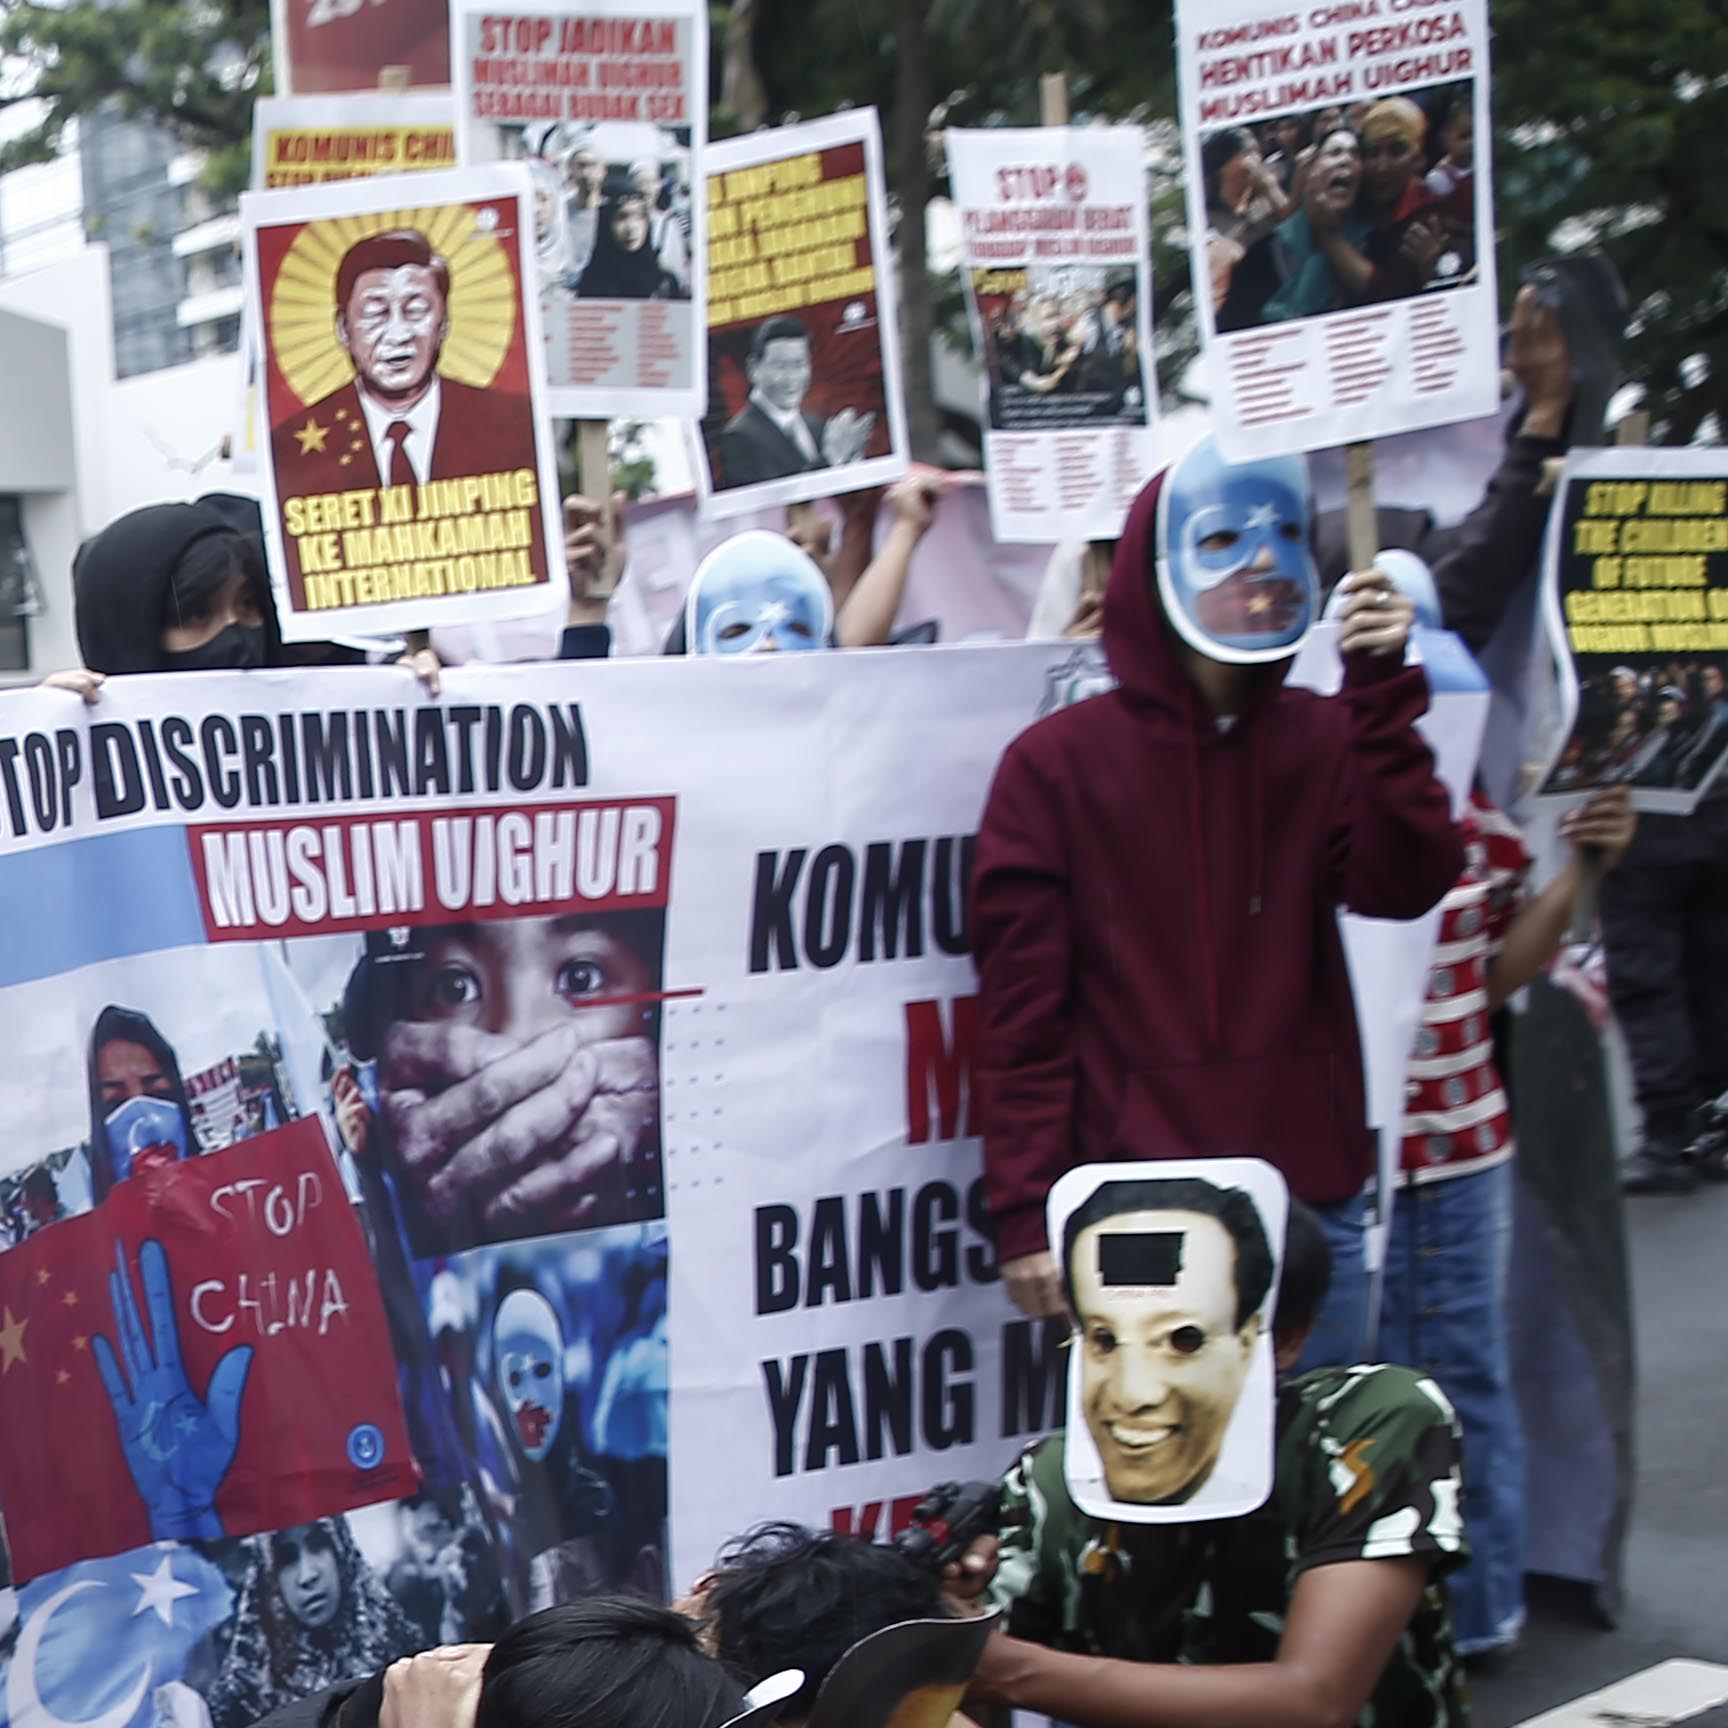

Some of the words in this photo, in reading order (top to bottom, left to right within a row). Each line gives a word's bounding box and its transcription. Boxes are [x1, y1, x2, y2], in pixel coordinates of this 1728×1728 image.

[482, 16, 551, 53] STOP
[560, 16, 677, 54] JADIKAN
[1198, 14, 1301, 50] KOMUNIS
[1200, 36, 1338, 88] HENTIKAN
[1348, 11, 1466, 59] PERKOSA
[1198, 71, 1352, 122] MUSLIMAH
[1363, 48, 1472, 90] UIGHUR
[277, 133, 396, 163] KOMUNIS
[284, 490, 375, 536] SERET
[379, 485, 411, 523] XI
[417, 469, 537, 520] JINPING
[299, 534, 342, 574] KE
[344, 509, 531, 568] MAHKAMAH
[304, 549, 537, 611] INTERNATIONAL
[91, 704, 589, 818] DISCRIMINATION
[202, 820, 425, 928] MUSLIM
[432, 806, 662, 911] UIGHUR
[211, 1172, 323, 1237] STOP
[190, 1268, 348, 1335] CHINA
[762, 1326, 975, 1478] YANG
